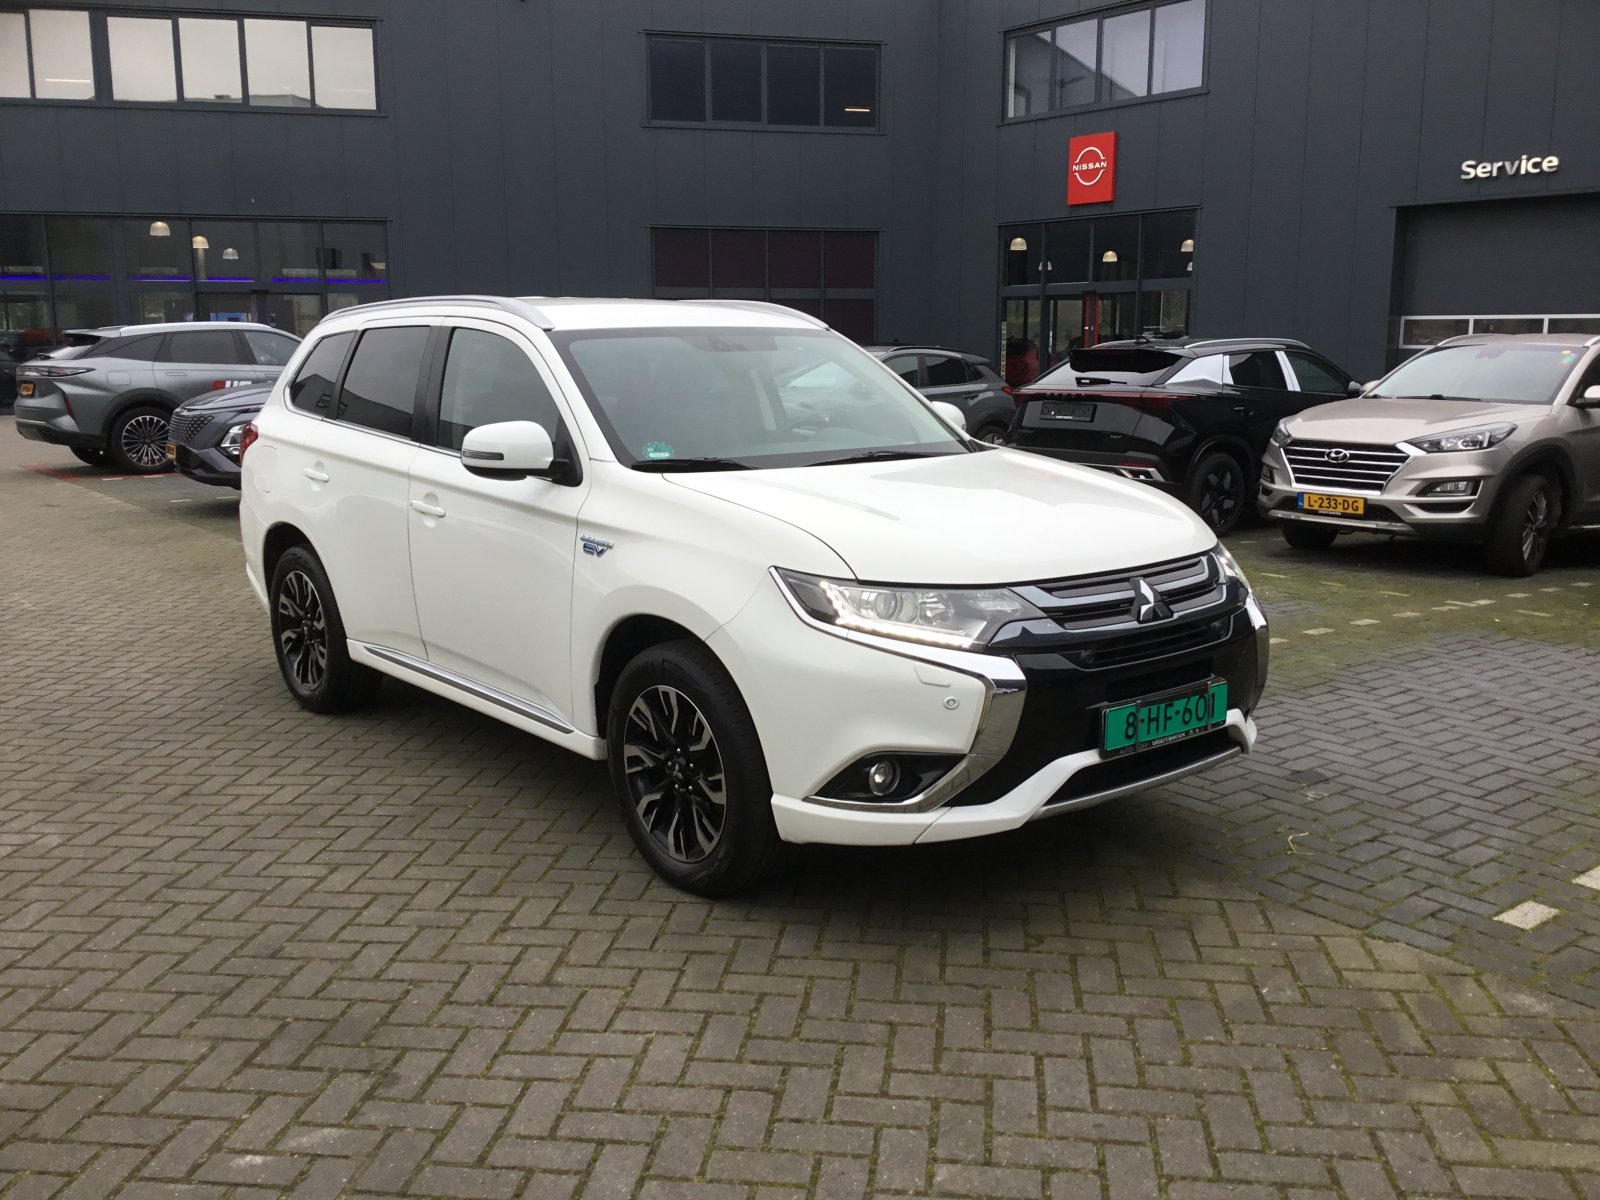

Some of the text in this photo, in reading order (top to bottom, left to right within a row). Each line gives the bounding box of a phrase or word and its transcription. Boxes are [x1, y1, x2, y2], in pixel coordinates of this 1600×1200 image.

[1072, 161, 1107, 171] NISSAN
[1461, 155, 1559, 179] Service
[1308, 496, 1359, 511] L-233-DG
